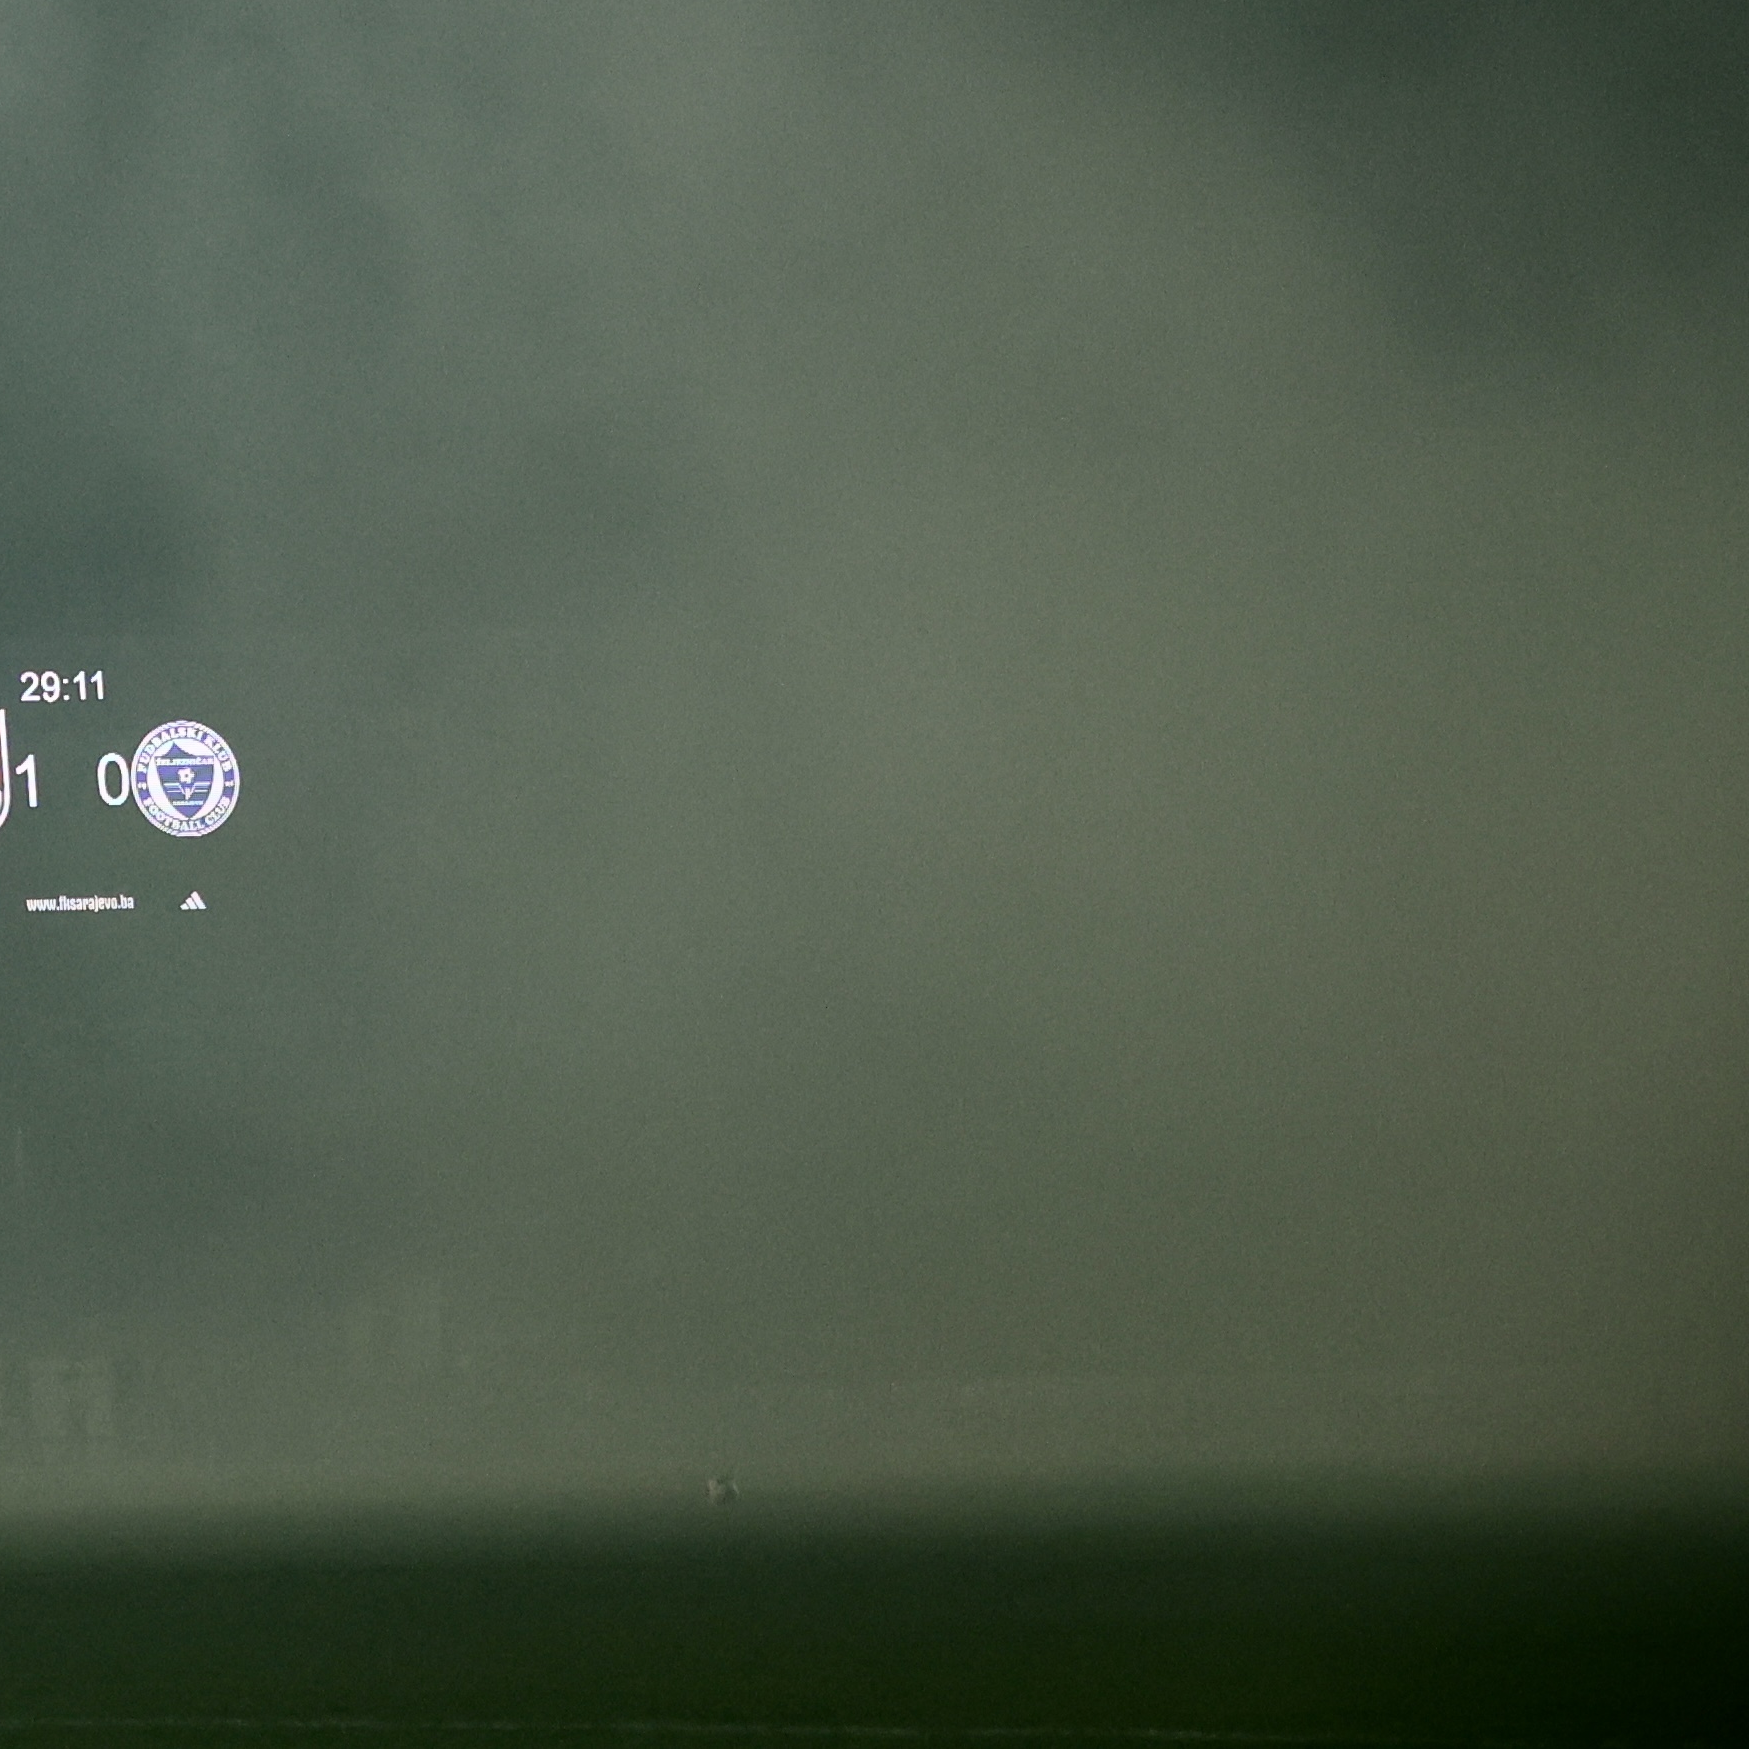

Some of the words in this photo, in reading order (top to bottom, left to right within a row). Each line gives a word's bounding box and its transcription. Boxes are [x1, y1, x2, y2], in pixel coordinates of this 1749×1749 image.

[20, 670, 104, 703] 29:11
[15, 753, 38, 808] 1
[97, 752, 130, 806] 0
[142, 796, 206, 832] FOOTBALL
[25, 894, 135, 913] www.fksarajevo.ba
